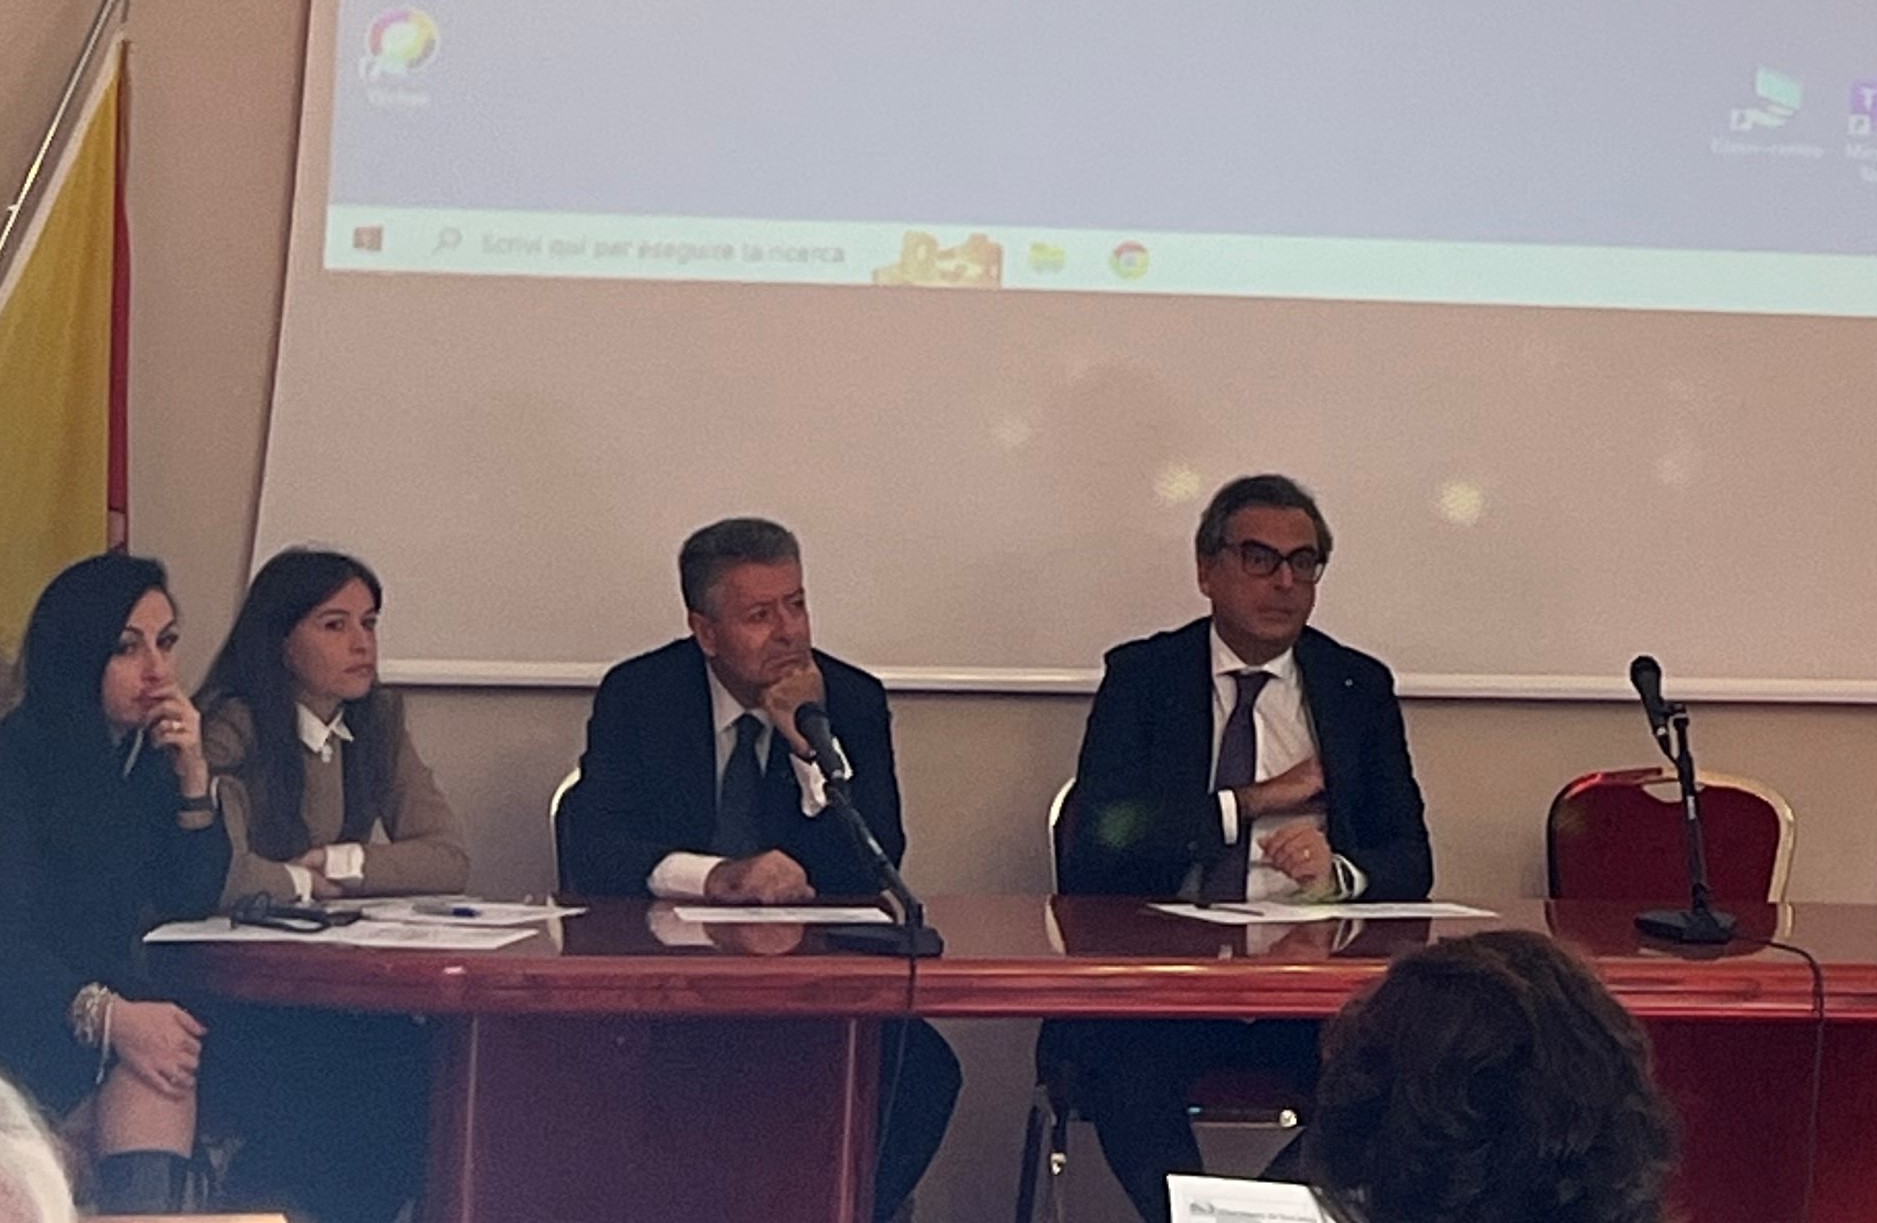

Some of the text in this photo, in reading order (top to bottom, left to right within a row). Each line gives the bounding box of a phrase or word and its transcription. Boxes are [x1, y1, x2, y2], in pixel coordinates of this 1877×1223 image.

[481, 233, 542, 256] Scrivi
[550, 235, 586, 260] qui
[594, 239, 633, 261] per
[638, 241, 734, 264] eseguire
